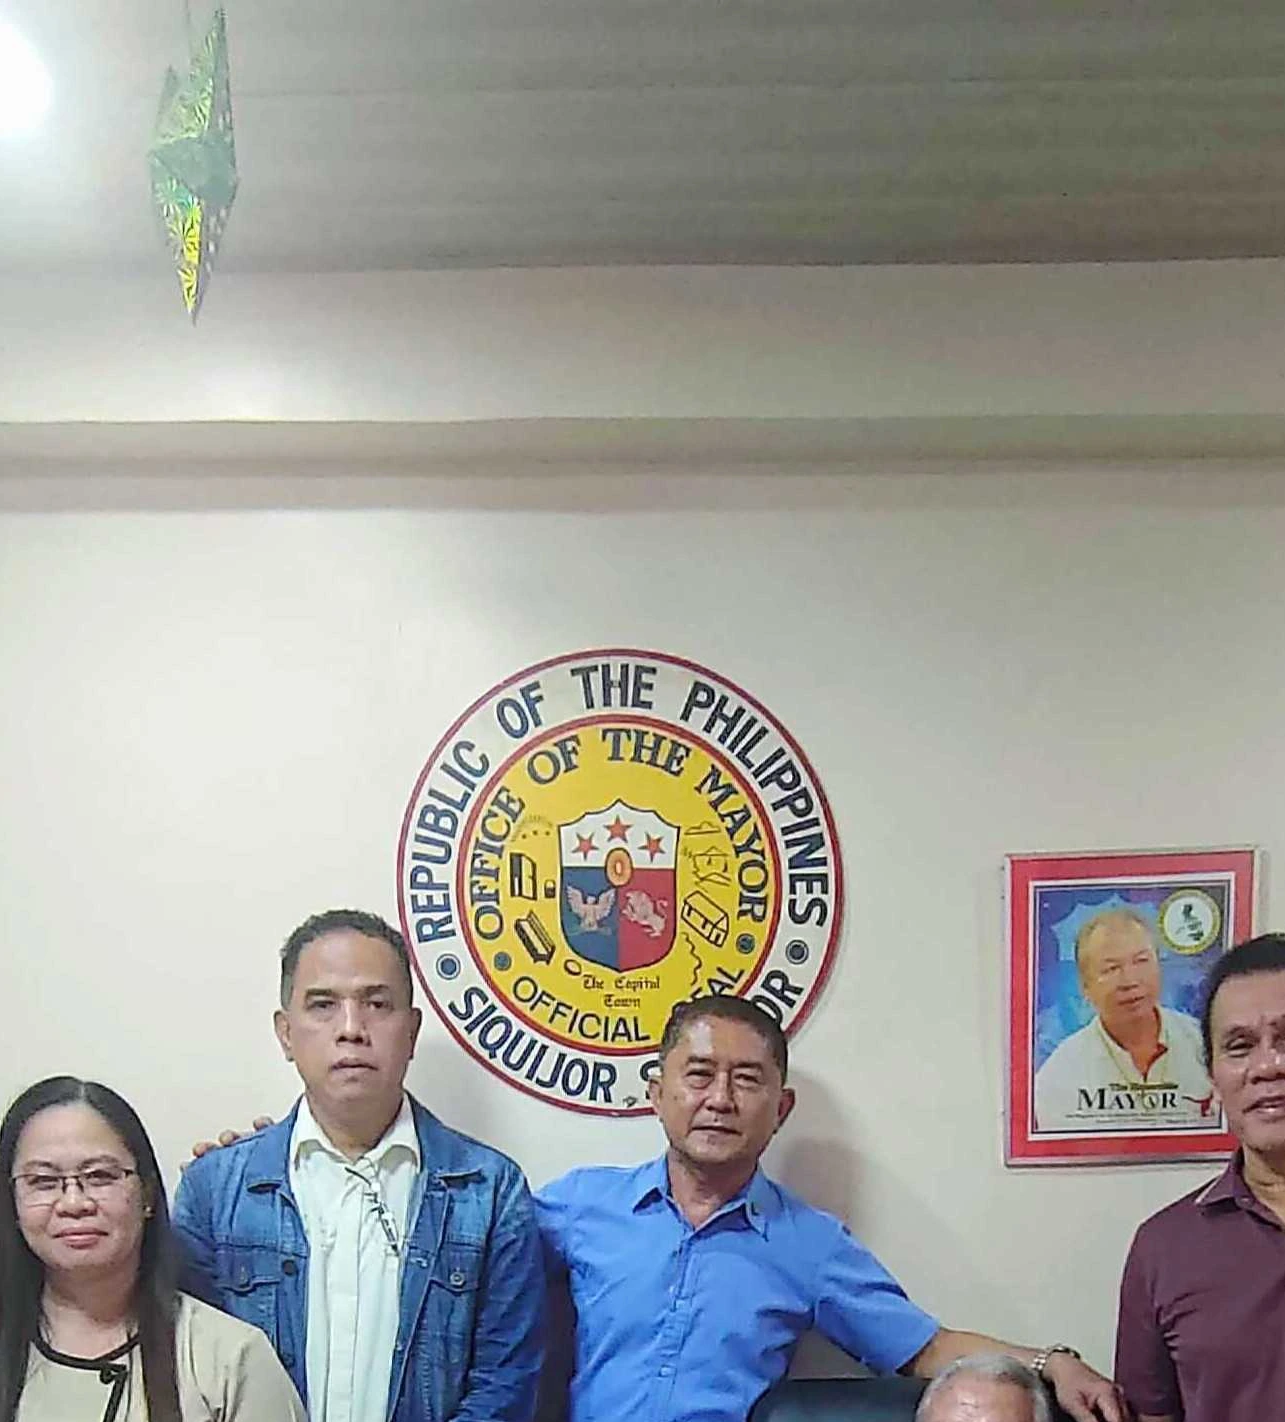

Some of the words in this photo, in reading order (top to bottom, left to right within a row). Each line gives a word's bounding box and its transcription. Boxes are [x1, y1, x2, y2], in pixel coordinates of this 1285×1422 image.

[410, 741, 490, 944] REPUBLIC
[496, 681, 546, 740] OF
[570, 662, 658, 710] THE
[680, 680, 829, 928] PHILIPPINES
[469, 788, 526, 941] OFFICE
[526, 737, 582, 785] OF
[602, 728, 693, 777] THE
[694, 766, 770, 924] MAYOR
[512, 975, 650, 1042] OFFICIAL
[583, 974, 605, 990] The
[614, 975, 661, 993] Capital
[603, 994, 641, 1009] Town
